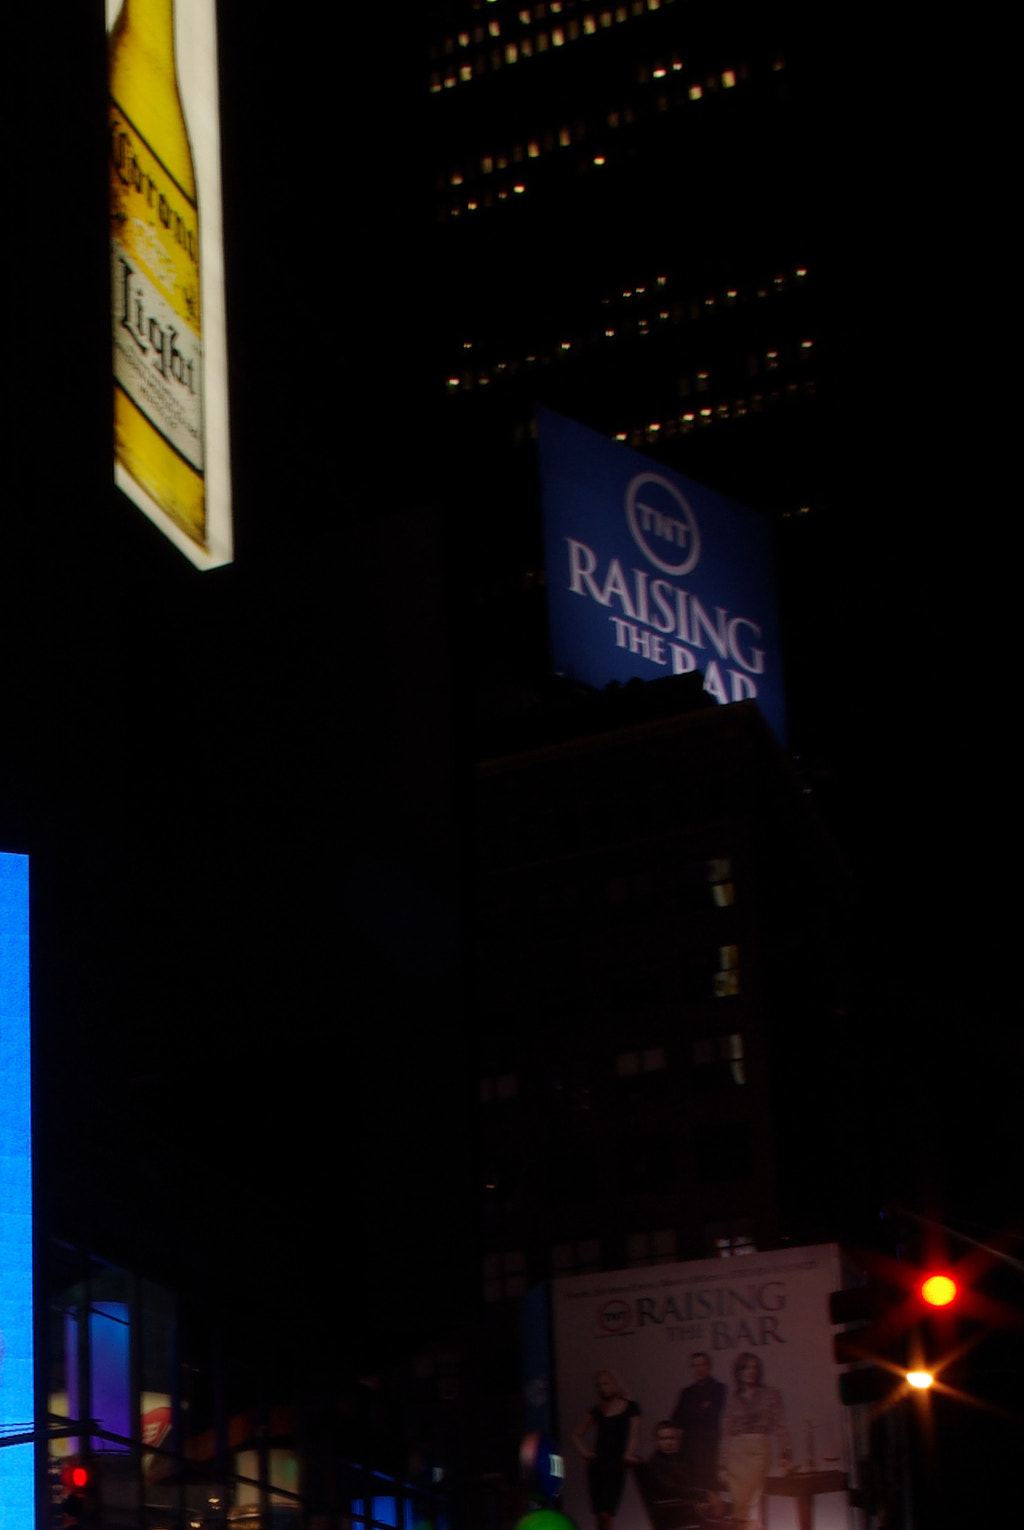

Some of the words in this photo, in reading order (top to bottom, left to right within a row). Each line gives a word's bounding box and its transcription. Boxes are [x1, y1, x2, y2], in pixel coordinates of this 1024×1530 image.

[119, 257, 196, 395] Light
[565, 536, 765, 674] RAISING
[609, 616, 667, 666] THE
[635, 1281, 787, 1327] RAISING
[666, 1324, 705, 1343] THE
[709, 1315, 787, 1350] BAR
